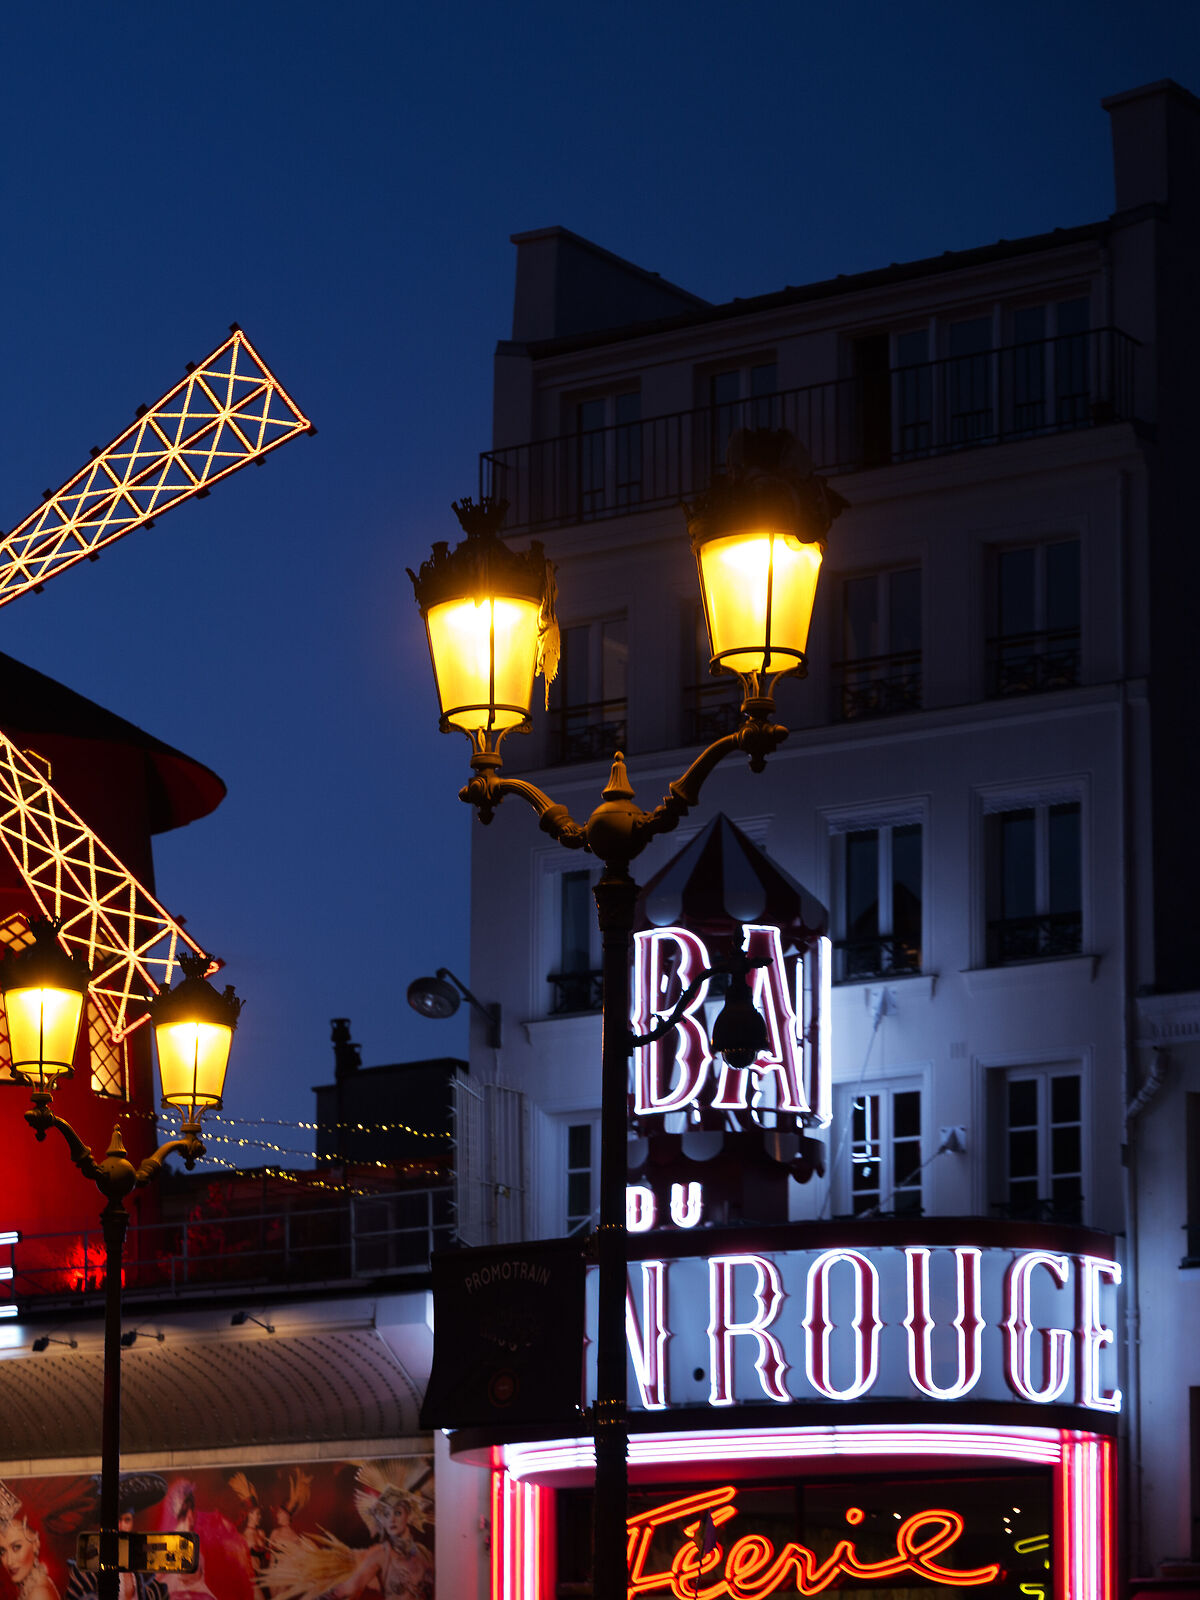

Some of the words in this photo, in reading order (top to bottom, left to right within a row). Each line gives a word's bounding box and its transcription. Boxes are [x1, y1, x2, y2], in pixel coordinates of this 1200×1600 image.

[626, 1181, 702, 1232] DU
[464, 1260, 551, 1295] PROMOTRAIN
[706, 1247, 1123, 1413] ROUGE
